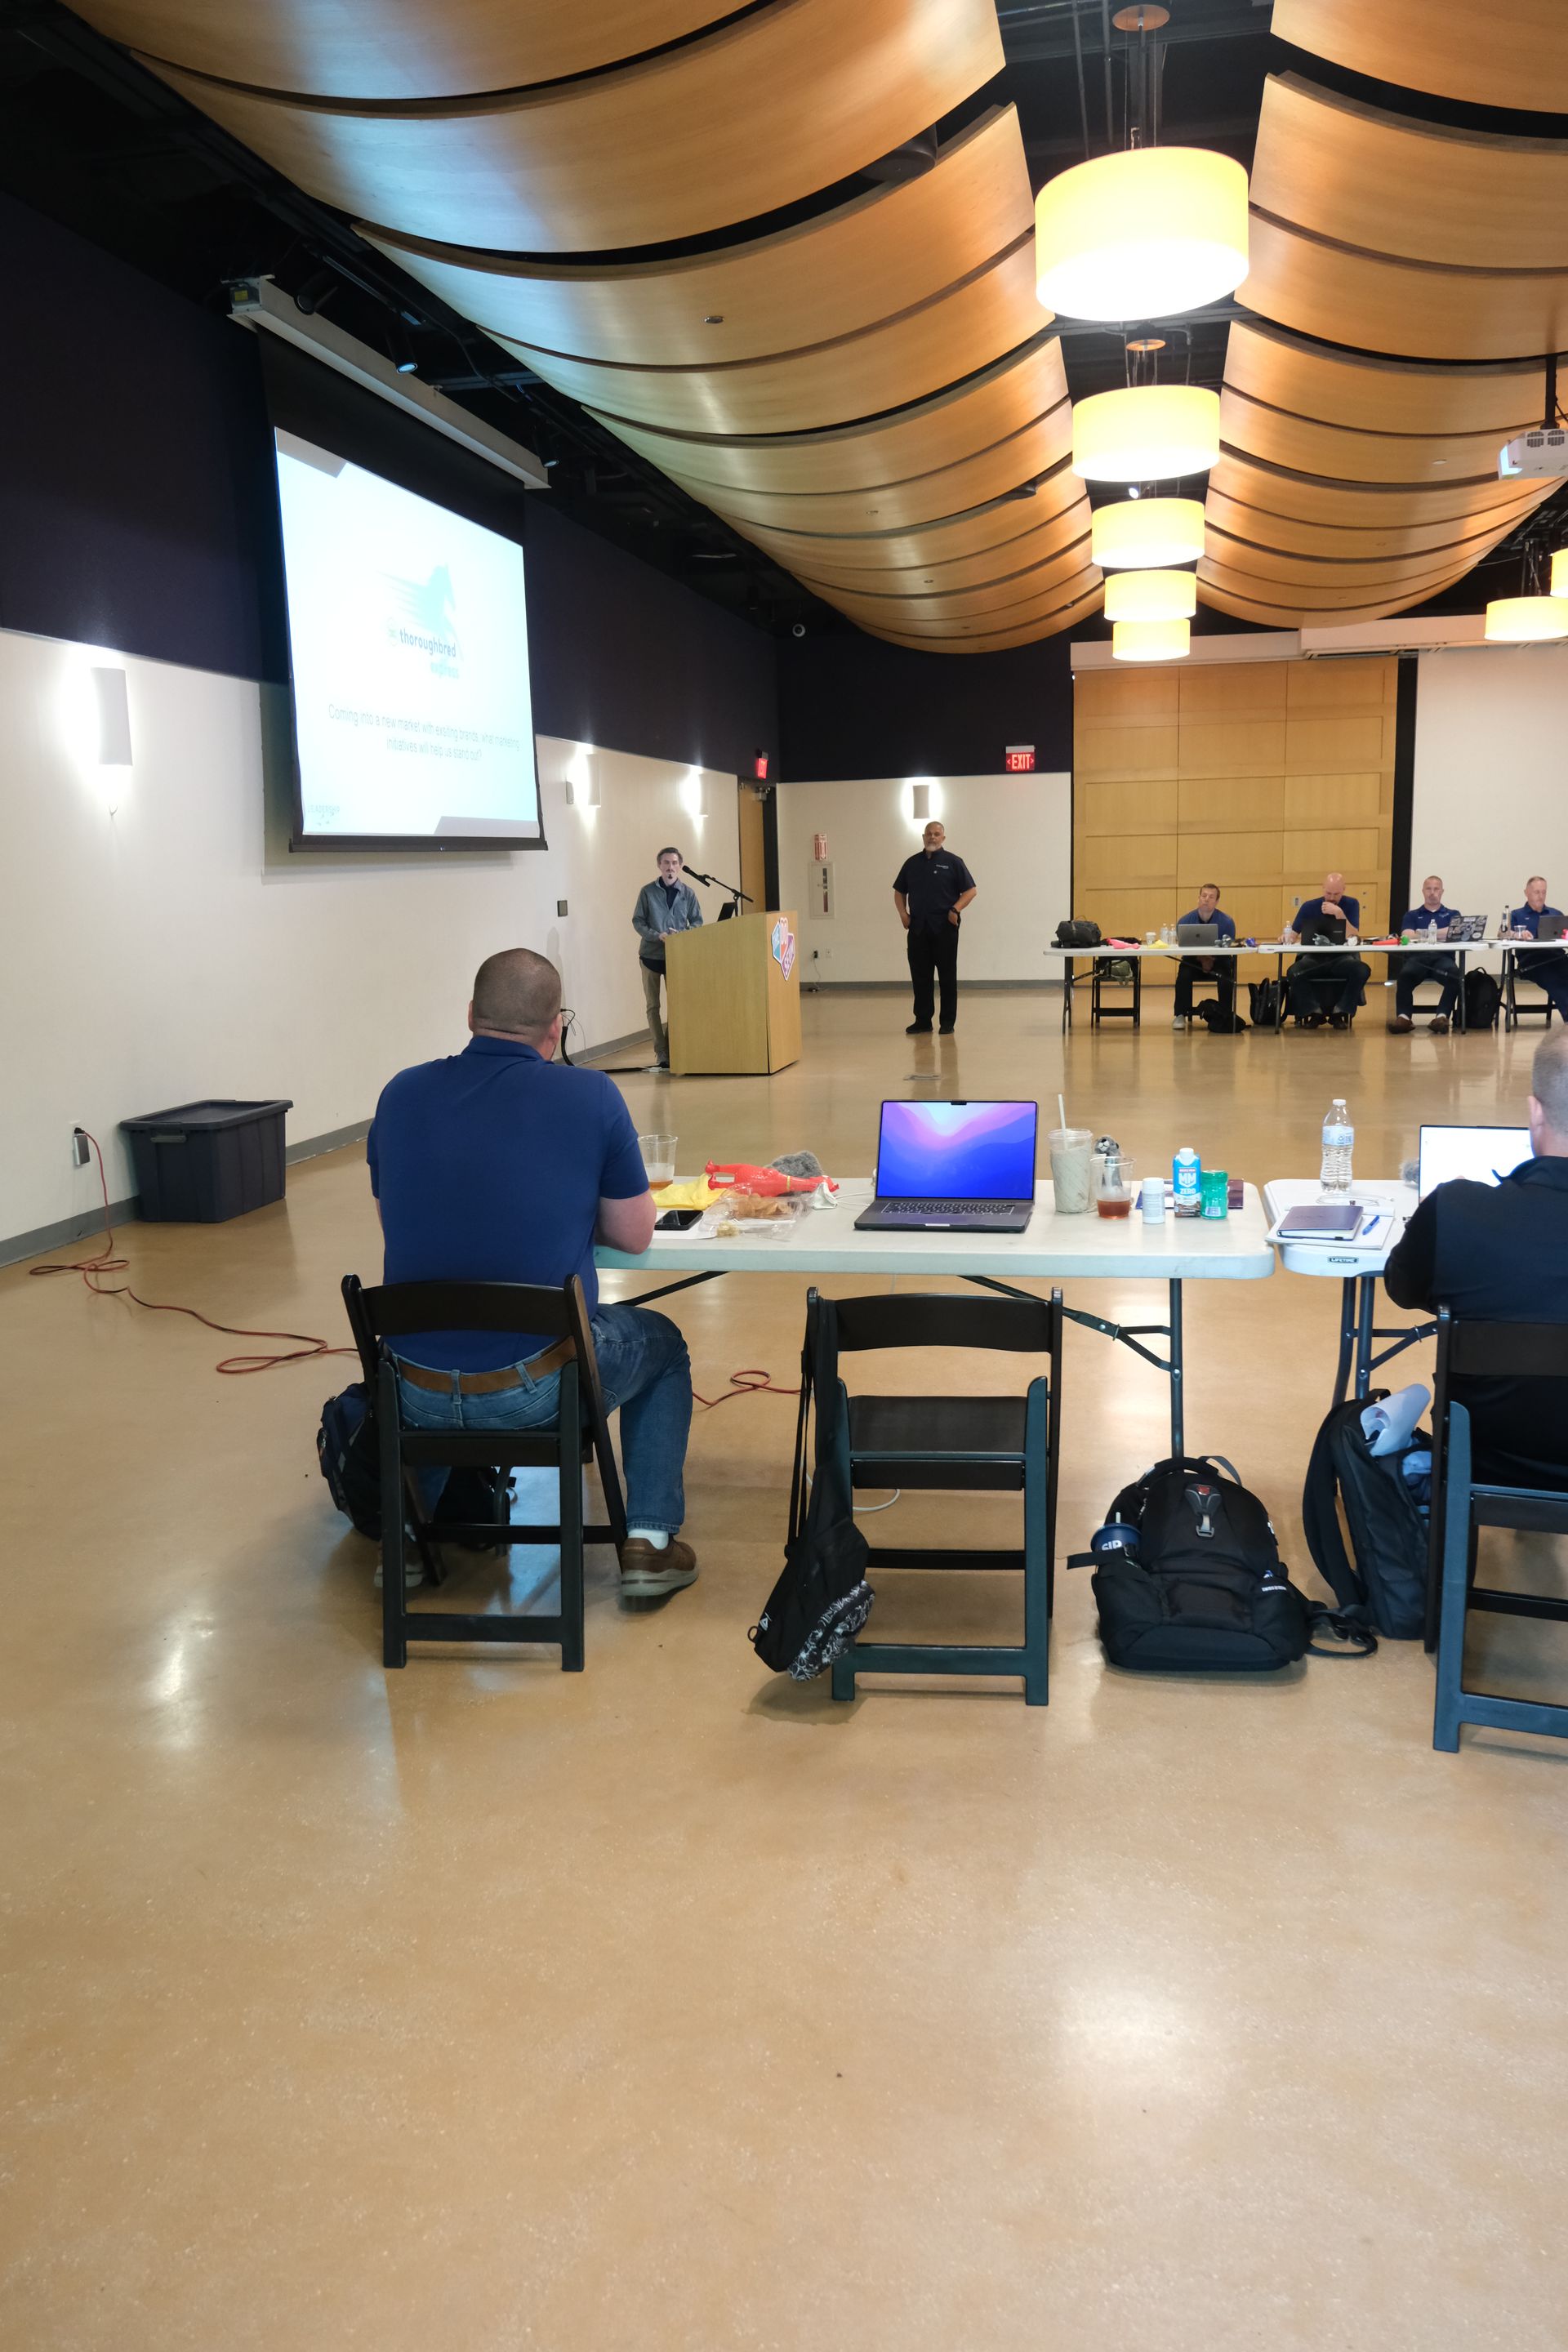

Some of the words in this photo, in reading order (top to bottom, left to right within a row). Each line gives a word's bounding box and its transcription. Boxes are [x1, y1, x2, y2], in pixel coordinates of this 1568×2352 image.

[399, 627, 457, 657] thoroughbred
[328, 703, 359, 727] Coming
[360, 710, 374, 725] into
[376, 715, 381, 726] a
[382, 715, 397, 728] new
[398, 718, 421, 733] market
[422, 722, 434, 734] with
[482, 732, 495, 745] what
[418, 741, 429, 754] will
[430, 742, 443, 759] help
[444, 746, 452, 758] us
[453, 746, 470, 760] stand
[470, 748, 483, 761] out?
[1012, 754, 1031, 769] EXIT
